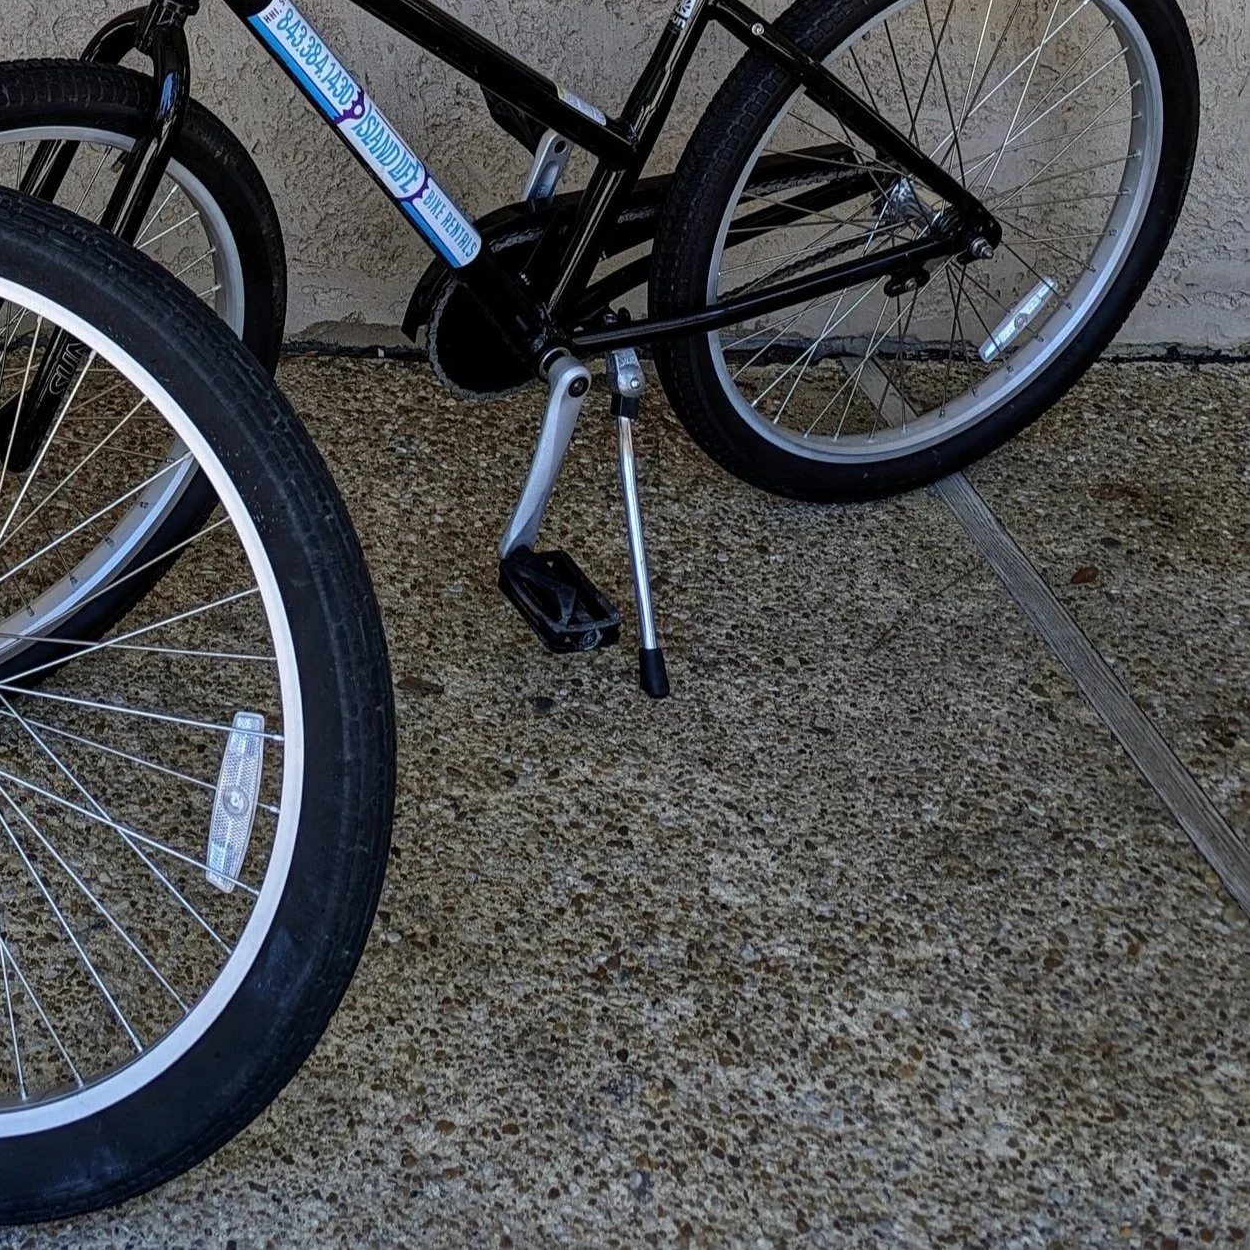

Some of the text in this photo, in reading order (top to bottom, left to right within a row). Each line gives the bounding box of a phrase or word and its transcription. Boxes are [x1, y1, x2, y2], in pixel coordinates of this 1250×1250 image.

[276, 8, 478, 258] 843.384.1430 ISLAND LIFE BIKE RENTALS
